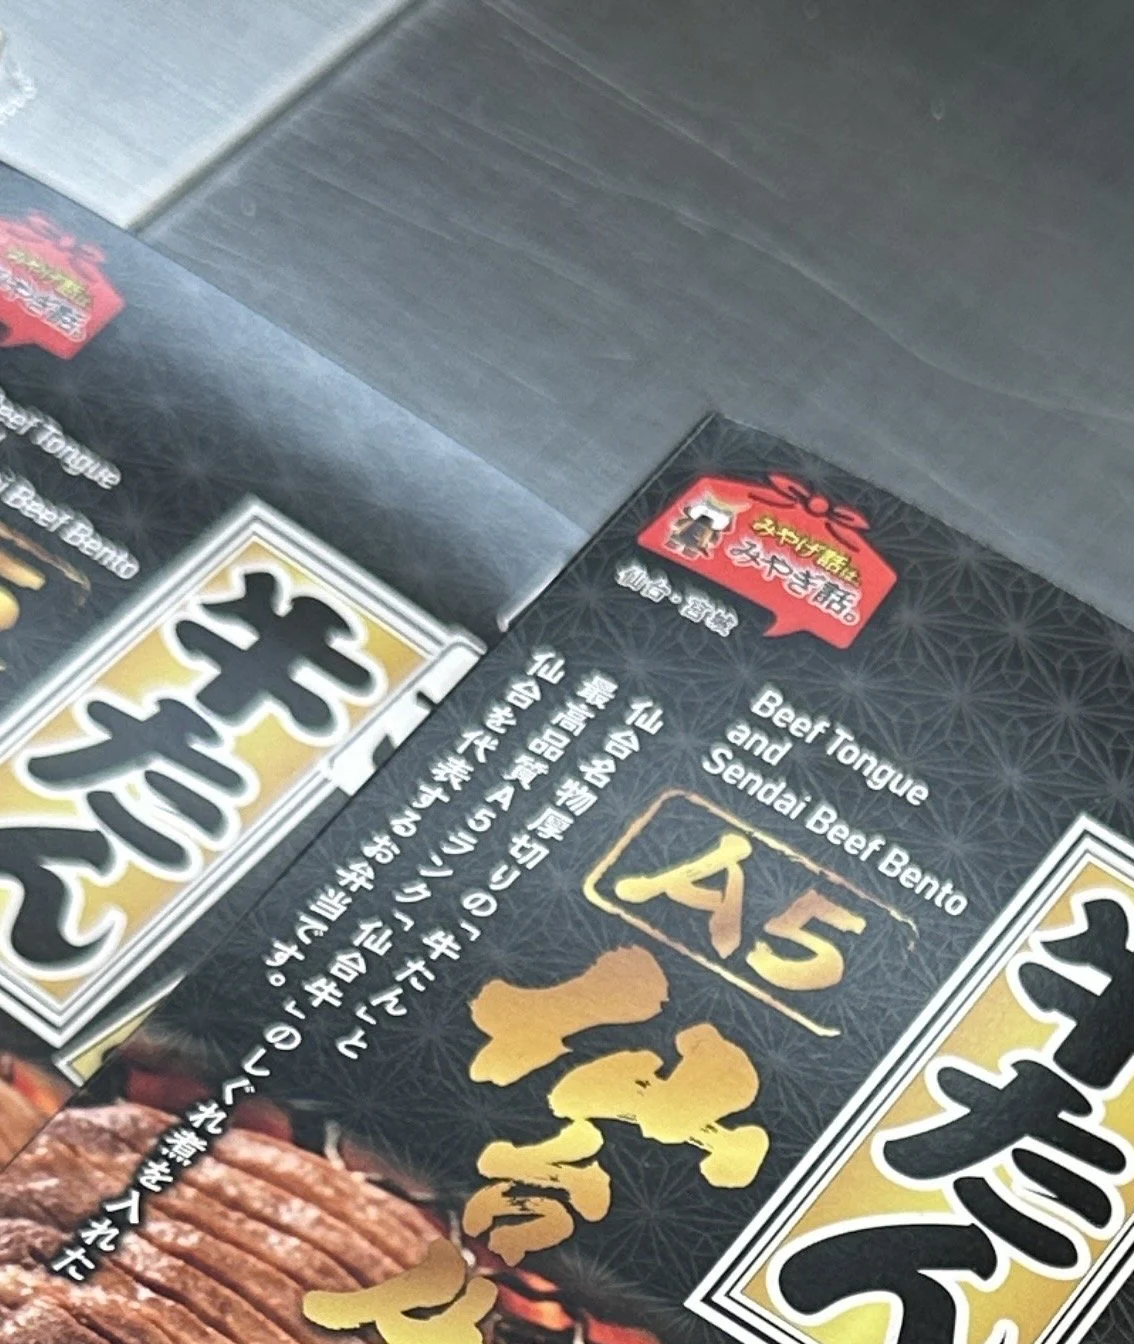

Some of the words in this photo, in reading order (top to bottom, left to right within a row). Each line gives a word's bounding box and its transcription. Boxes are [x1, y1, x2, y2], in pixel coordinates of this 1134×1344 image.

[0, 385, 41, 435] eef
[33, 415, 122, 490] Tongue
[4, 472, 67, 532] Beef
[59, 510, 141, 581] Bento
[727, 539, 860, 625] みやぎ話。
[616, 560, 740, 637] 仙台・宮城
[726, 718, 793, 767] and
[751, 683, 830, 743] Beef
[826, 720, 930, 806] Tongue
[264, 650, 566, 988] 仙台を代表するお弁当です。
[702, 744, 813, 820] Sendai
[805, 801, 886, 863] Beef
[878, 846, 969, 917] Bento
[336, 697, 665, 1060] 仙台名物厚切りの「牛たん」と
[614, 832, 867, 992] A5
